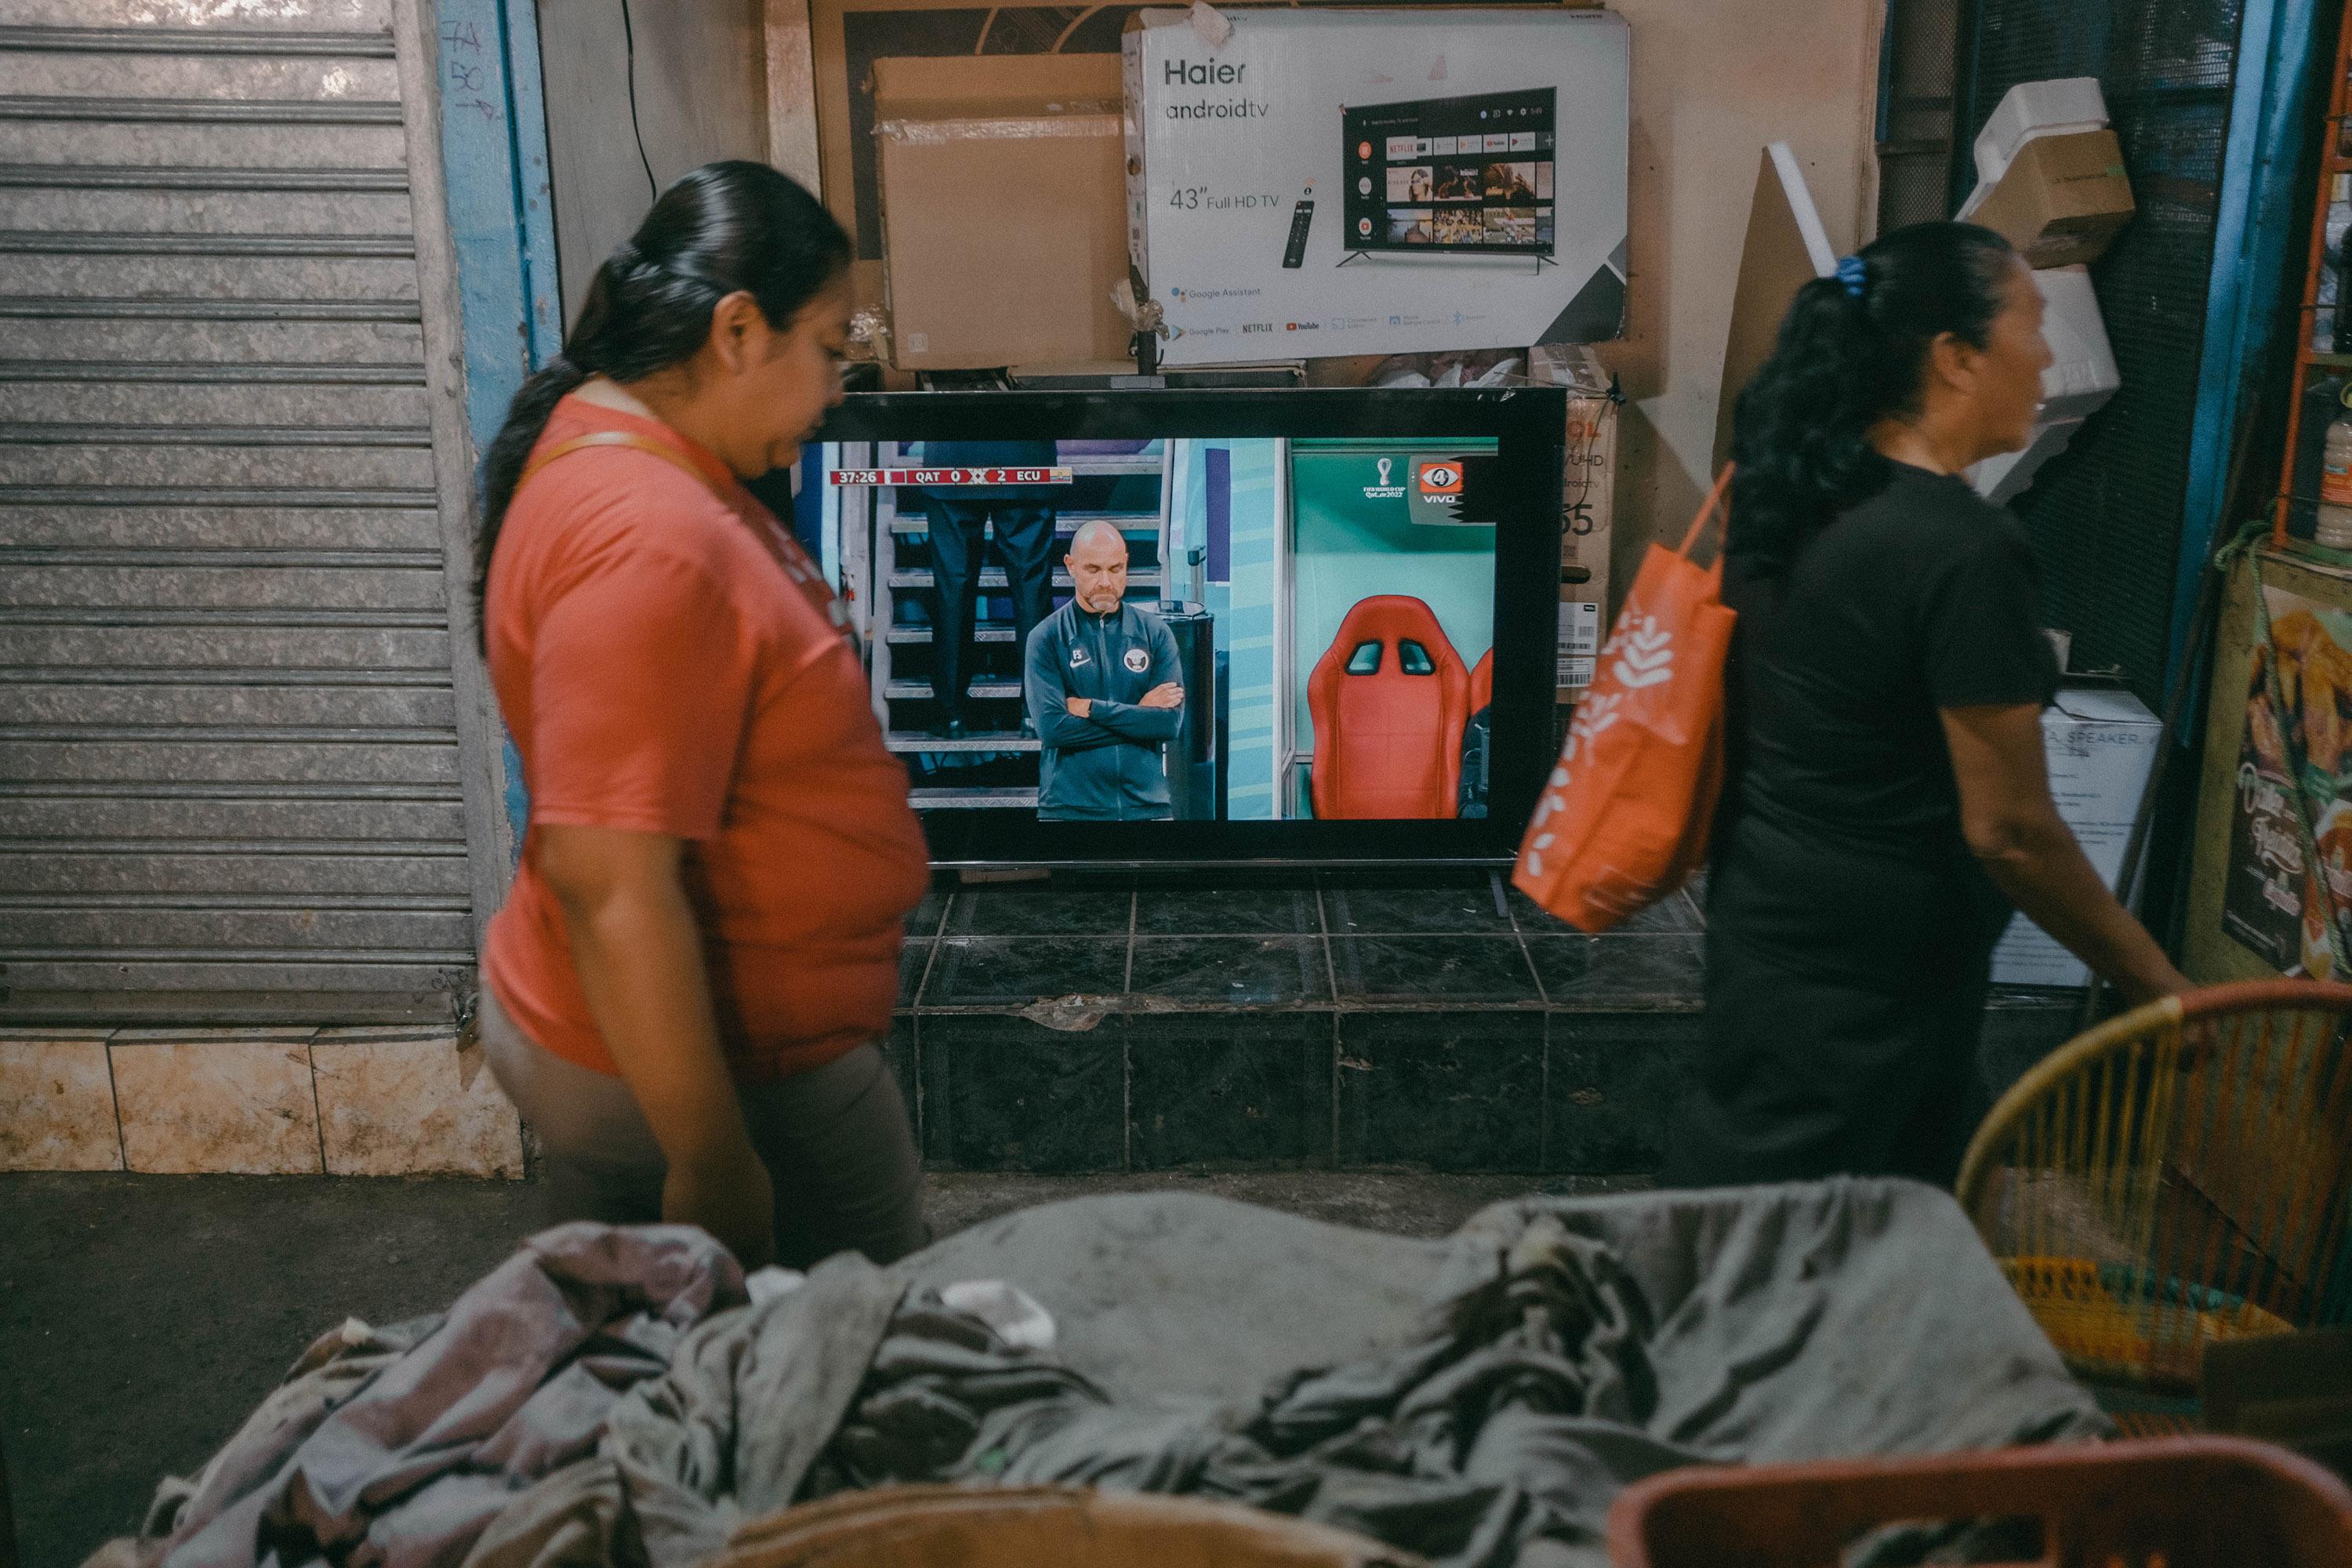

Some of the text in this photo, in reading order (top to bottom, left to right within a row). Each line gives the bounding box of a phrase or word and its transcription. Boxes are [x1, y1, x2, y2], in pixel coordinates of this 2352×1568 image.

[1165, 57, 1246, 85] Haier
[1167, 98, 1269, 118] androidtv
[1207, 196, 1230, 209] Full
[1235, 195, 1256, 208] HD
[1262, 194, 1279, 207] TV
[1189, 288, 1261, 299] Google Assistant
[1243, 324, 1272, 333] NETFLIX
[839, 471, 877, 483] 37:26
[915, 470, 1040, 483] QAT 0 2 ECU
[1423, 495, 1456, 503] VIVO
